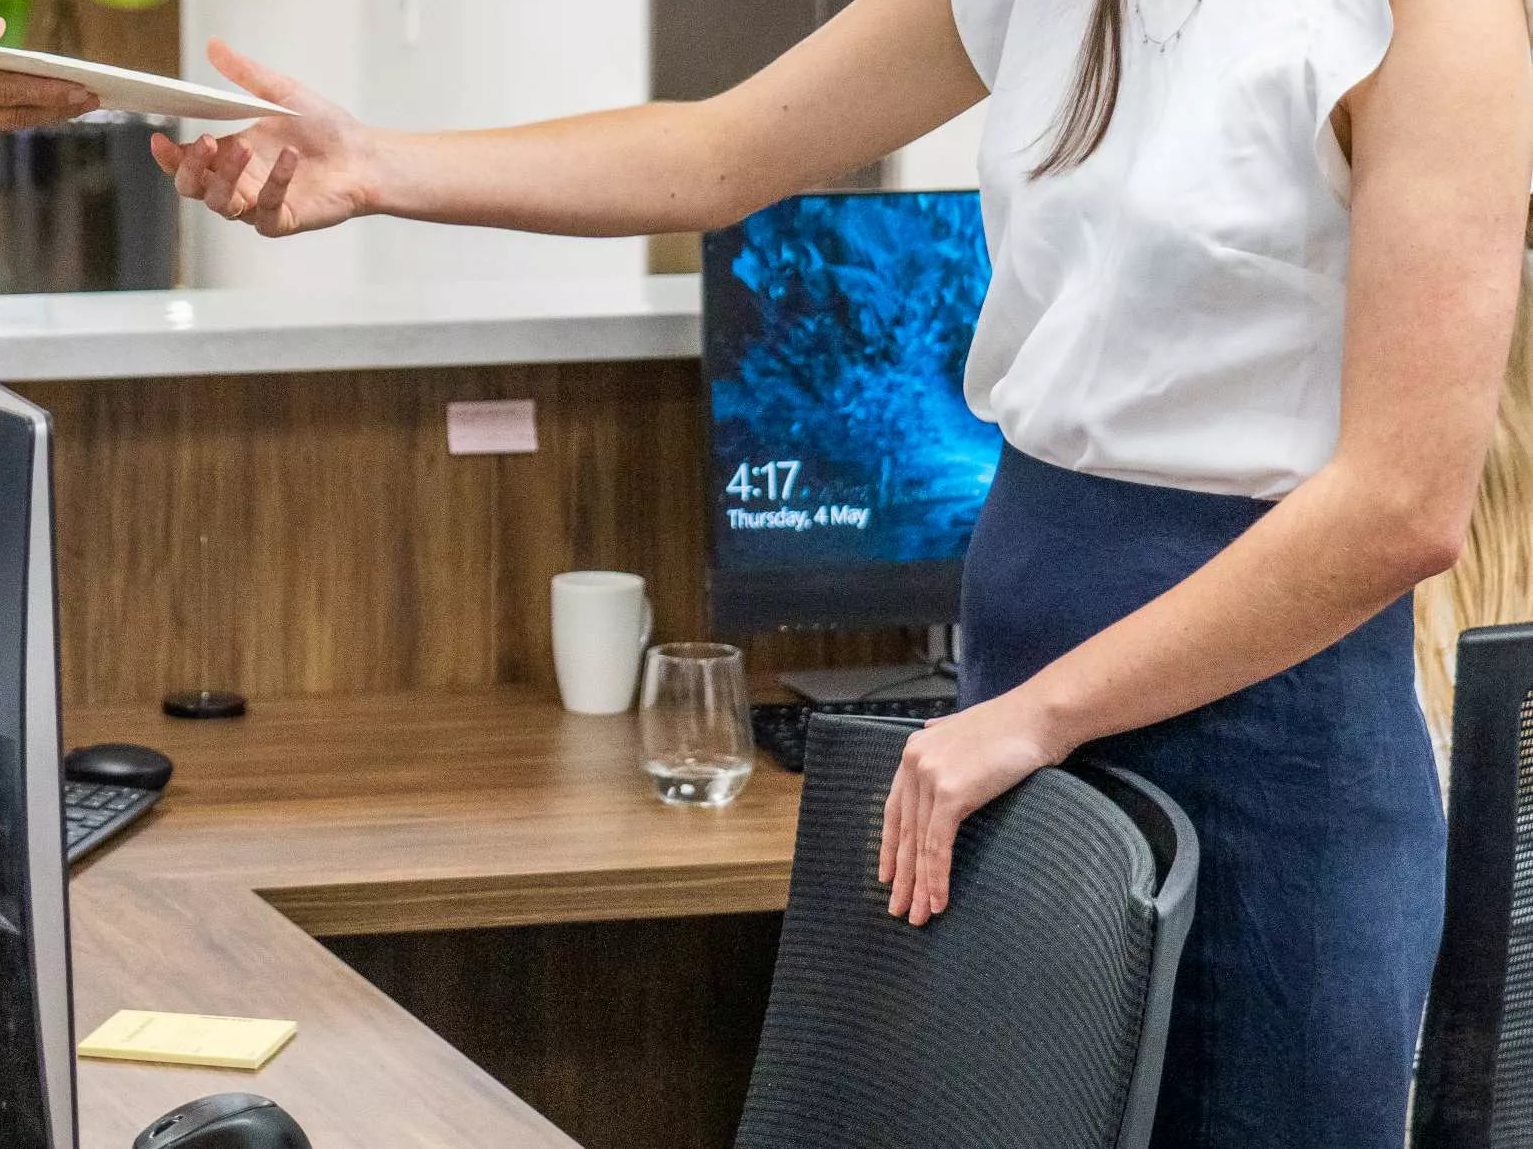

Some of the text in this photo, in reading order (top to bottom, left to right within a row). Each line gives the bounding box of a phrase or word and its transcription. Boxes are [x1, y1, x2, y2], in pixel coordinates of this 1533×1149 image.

[725, 459, 802, 501] 4:17
[726, 505, 871, 531] Thursday, 4 May
